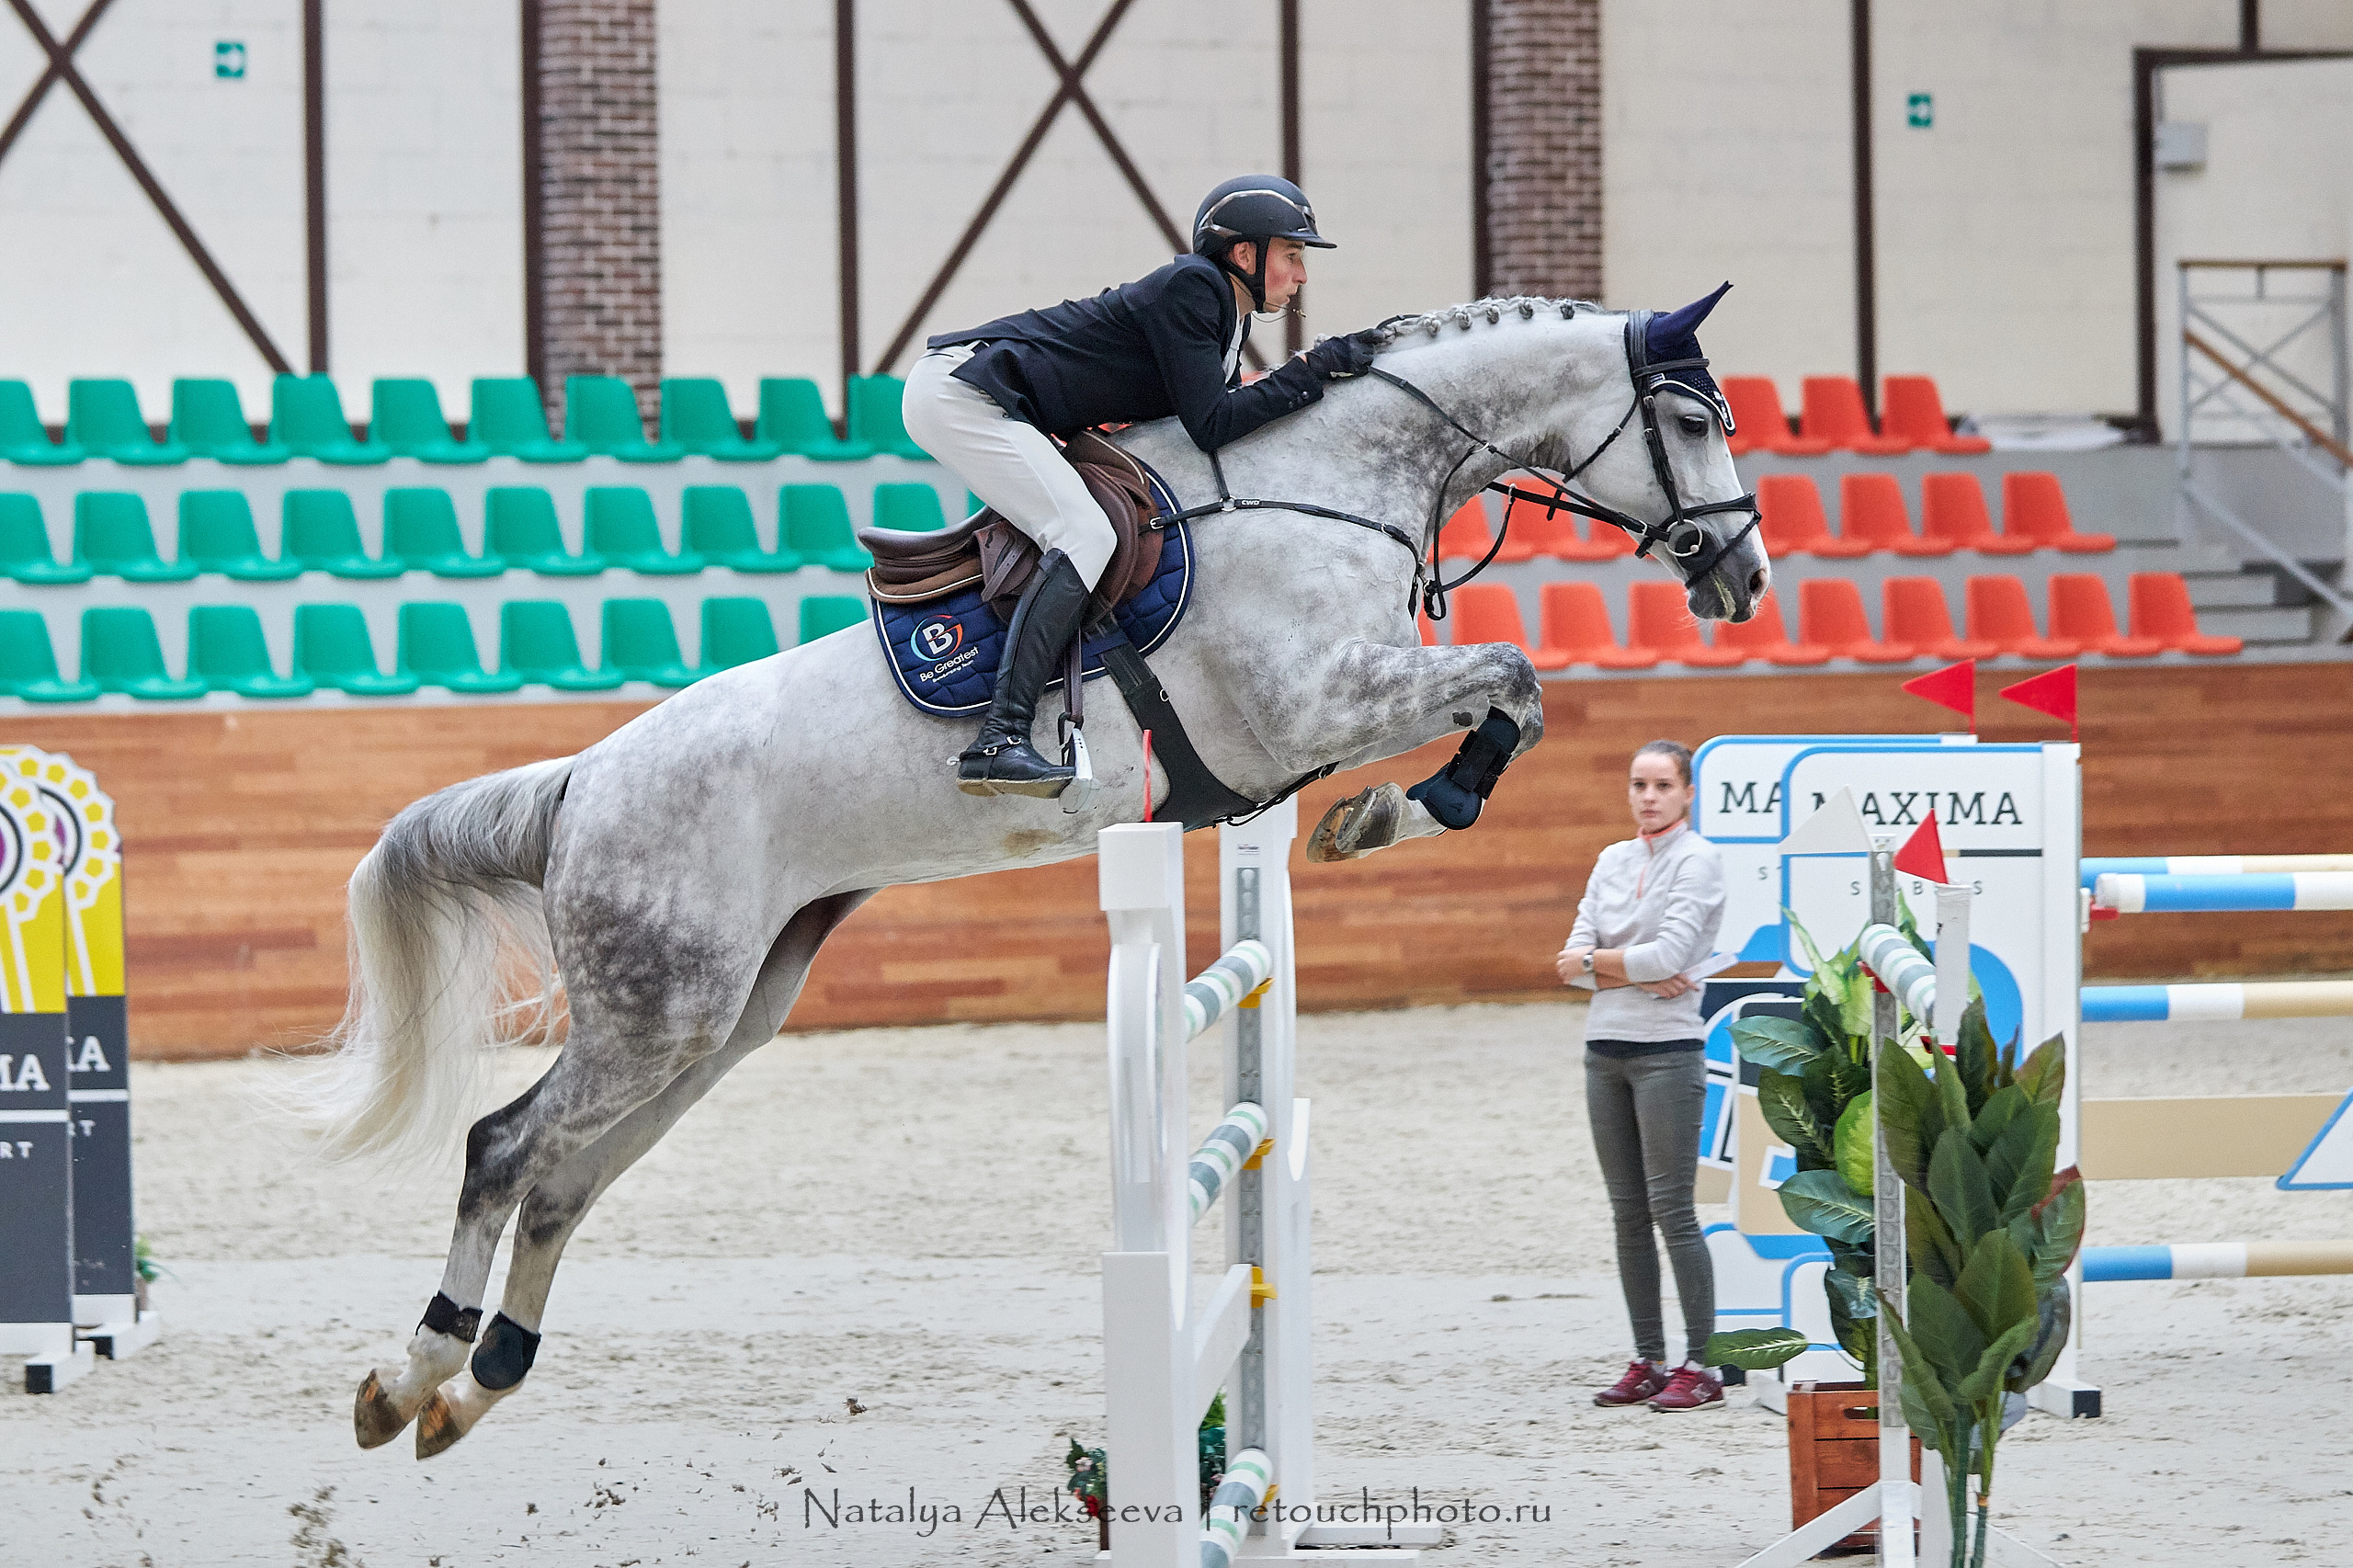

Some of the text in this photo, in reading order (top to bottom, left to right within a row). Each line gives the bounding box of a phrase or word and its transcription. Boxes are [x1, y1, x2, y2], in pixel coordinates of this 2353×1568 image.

[922, 623, 953, 654] B
[919, 671, 934, 682] Be
[934, 645, 979, 674] Greatest
